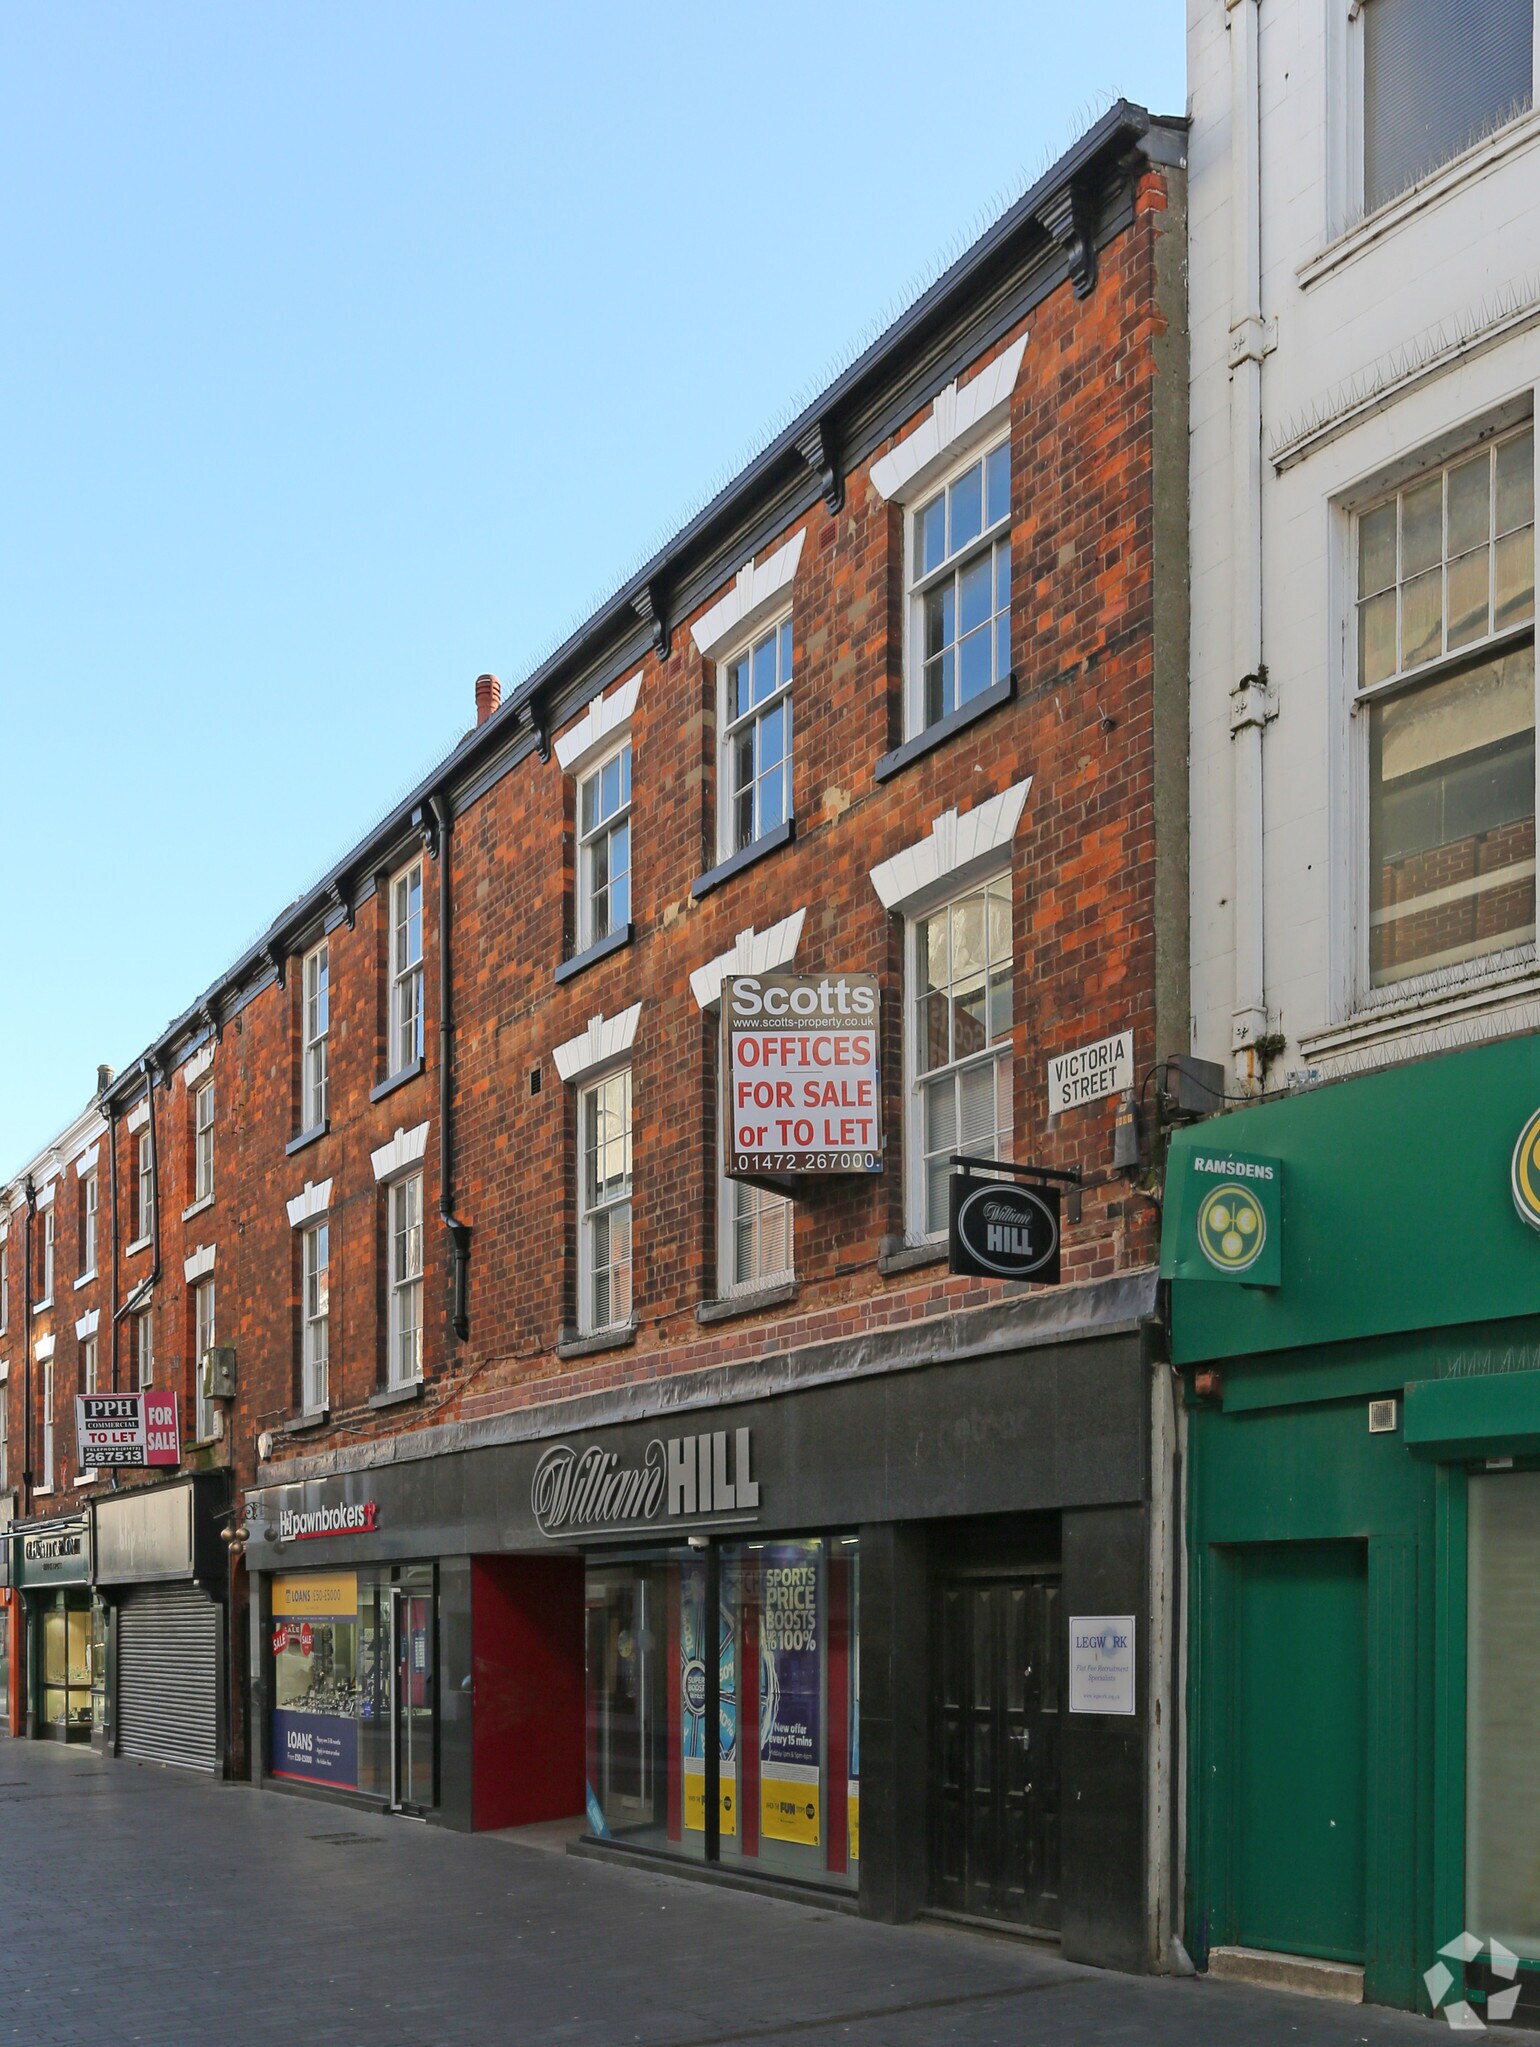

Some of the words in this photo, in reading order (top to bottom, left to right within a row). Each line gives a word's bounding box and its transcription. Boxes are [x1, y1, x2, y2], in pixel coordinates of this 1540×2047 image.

[731, 978, 875, 1015] Scotts
[733, 1016, 874, 1028] www.scotts-property.co.uk
[737, 1035, 871, 1067] OFFICES
[1055, 1039, 1124, 1082] VICTORIA
[737, 1081, 795, 1108] FOR
[803, 1080, 872, 1107] SALE
[1062, 1066, 1117, 1104] STREET
[739, 1125, 768, 1147] or
[775, 1119, 814, 1146] TO
[824, 1118, 873, 1145] LET
[738, 1154, 796, 1170] 01472
[1194, 1157, 1274, 1180] RAMSDENS
[983, 1201, 1033, 1226] William
[987, 1223, 1033, 1256] HILL
[90, 1400, 133, 1417] PPH
[148, 1406, 173, 1426] FOR
[87, 1420, 137, 1429] COMMERCIAL
[89, 1431, 107, 1443] TO
[112, 1431, 136, 1443] LET
[147, 1431, 176, 1451] SALE
[85, 1451, 142, 1462] 267513
[531, 1439, 667, 1528] William
[668, 1427, 759, 1515] HILL
[766, 1567, 816, 1587] SPORTS
[291, 1588, 311, 1602] LOANS
[766, 1586, 816, 1610] PRICE
[766, 1610, 816, 1630] BOOSTS
[273, 1633, 286, 1651] SALE
[301, 1635, 312, 1644] SALE
[766, 1640, 777, 1650] TO
[777, 1630, 816, 1651] 100%
[774, 1722, 790, 1733] New
[790, 1723, 807, 1735] offer
[287, 1731, 313, 1752] LOANS
[788, 1735, 795, 1745] 15
[796, 1735, 813, 1747] mins
[780, 1801, 796, 1815] FUN
